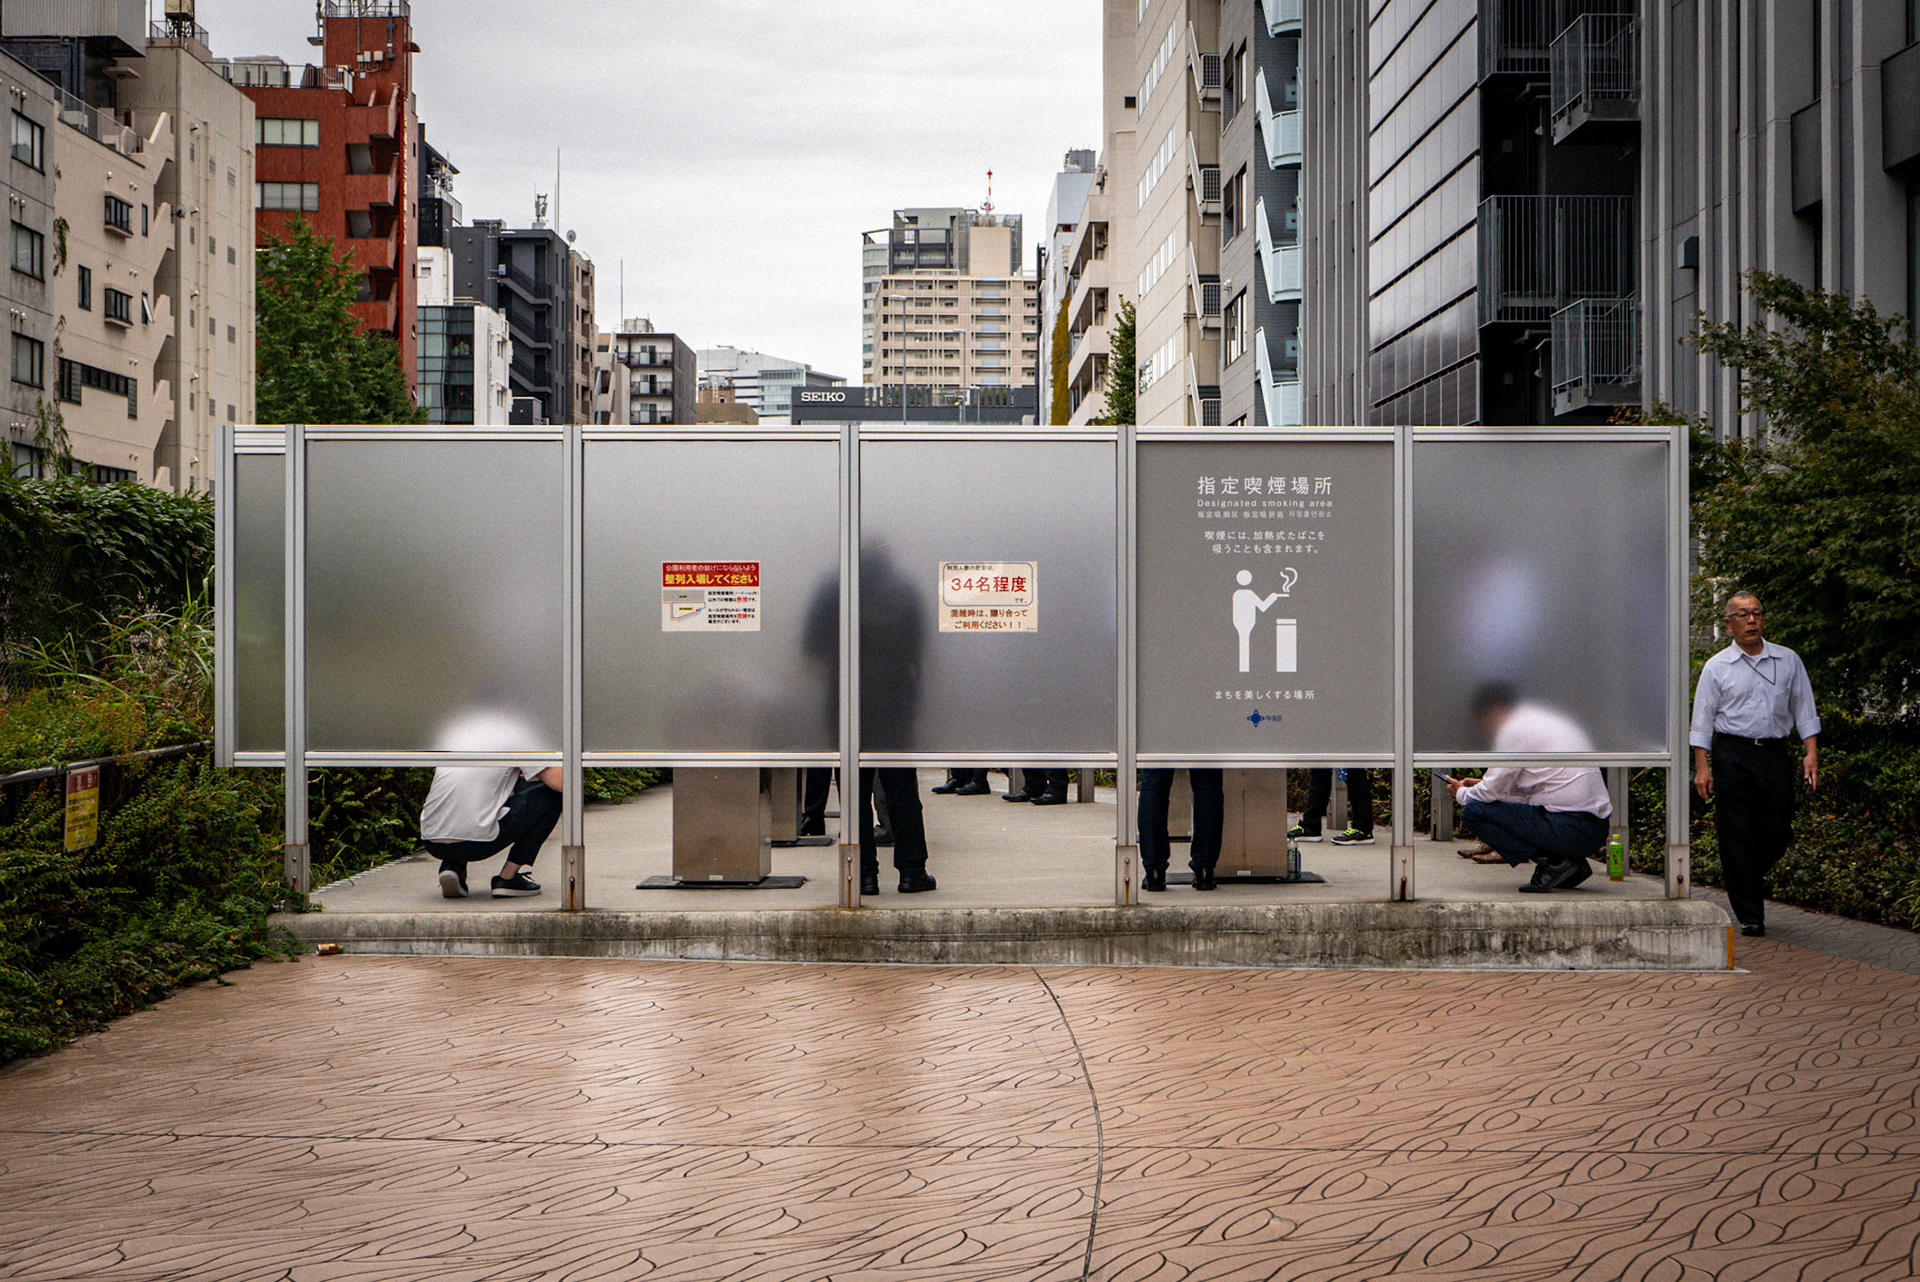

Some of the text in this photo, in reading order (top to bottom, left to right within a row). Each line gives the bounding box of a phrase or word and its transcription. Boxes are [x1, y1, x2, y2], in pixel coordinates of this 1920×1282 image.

[801, 391, 846, 402] SEIKO
[1197, 476, 1332, 495] 指定喫煙場所
[1197, 499, 1257, 509] Designated
[1262, 499, 1305, 509] smoking
[1204, 530, 1325, 540] 喫煙には、加熱式たばこを
[1212, 543, 1319, 554] 吸うことも含まれます。
[664, 573, 758, 585] 整列入場してください
[951, 576, 1027, 593] 34名程度
[950, 609, 1028, 618] 混雑時は、譲り合って
[1214, 690, 1315, 700] まちを美しくする場所
